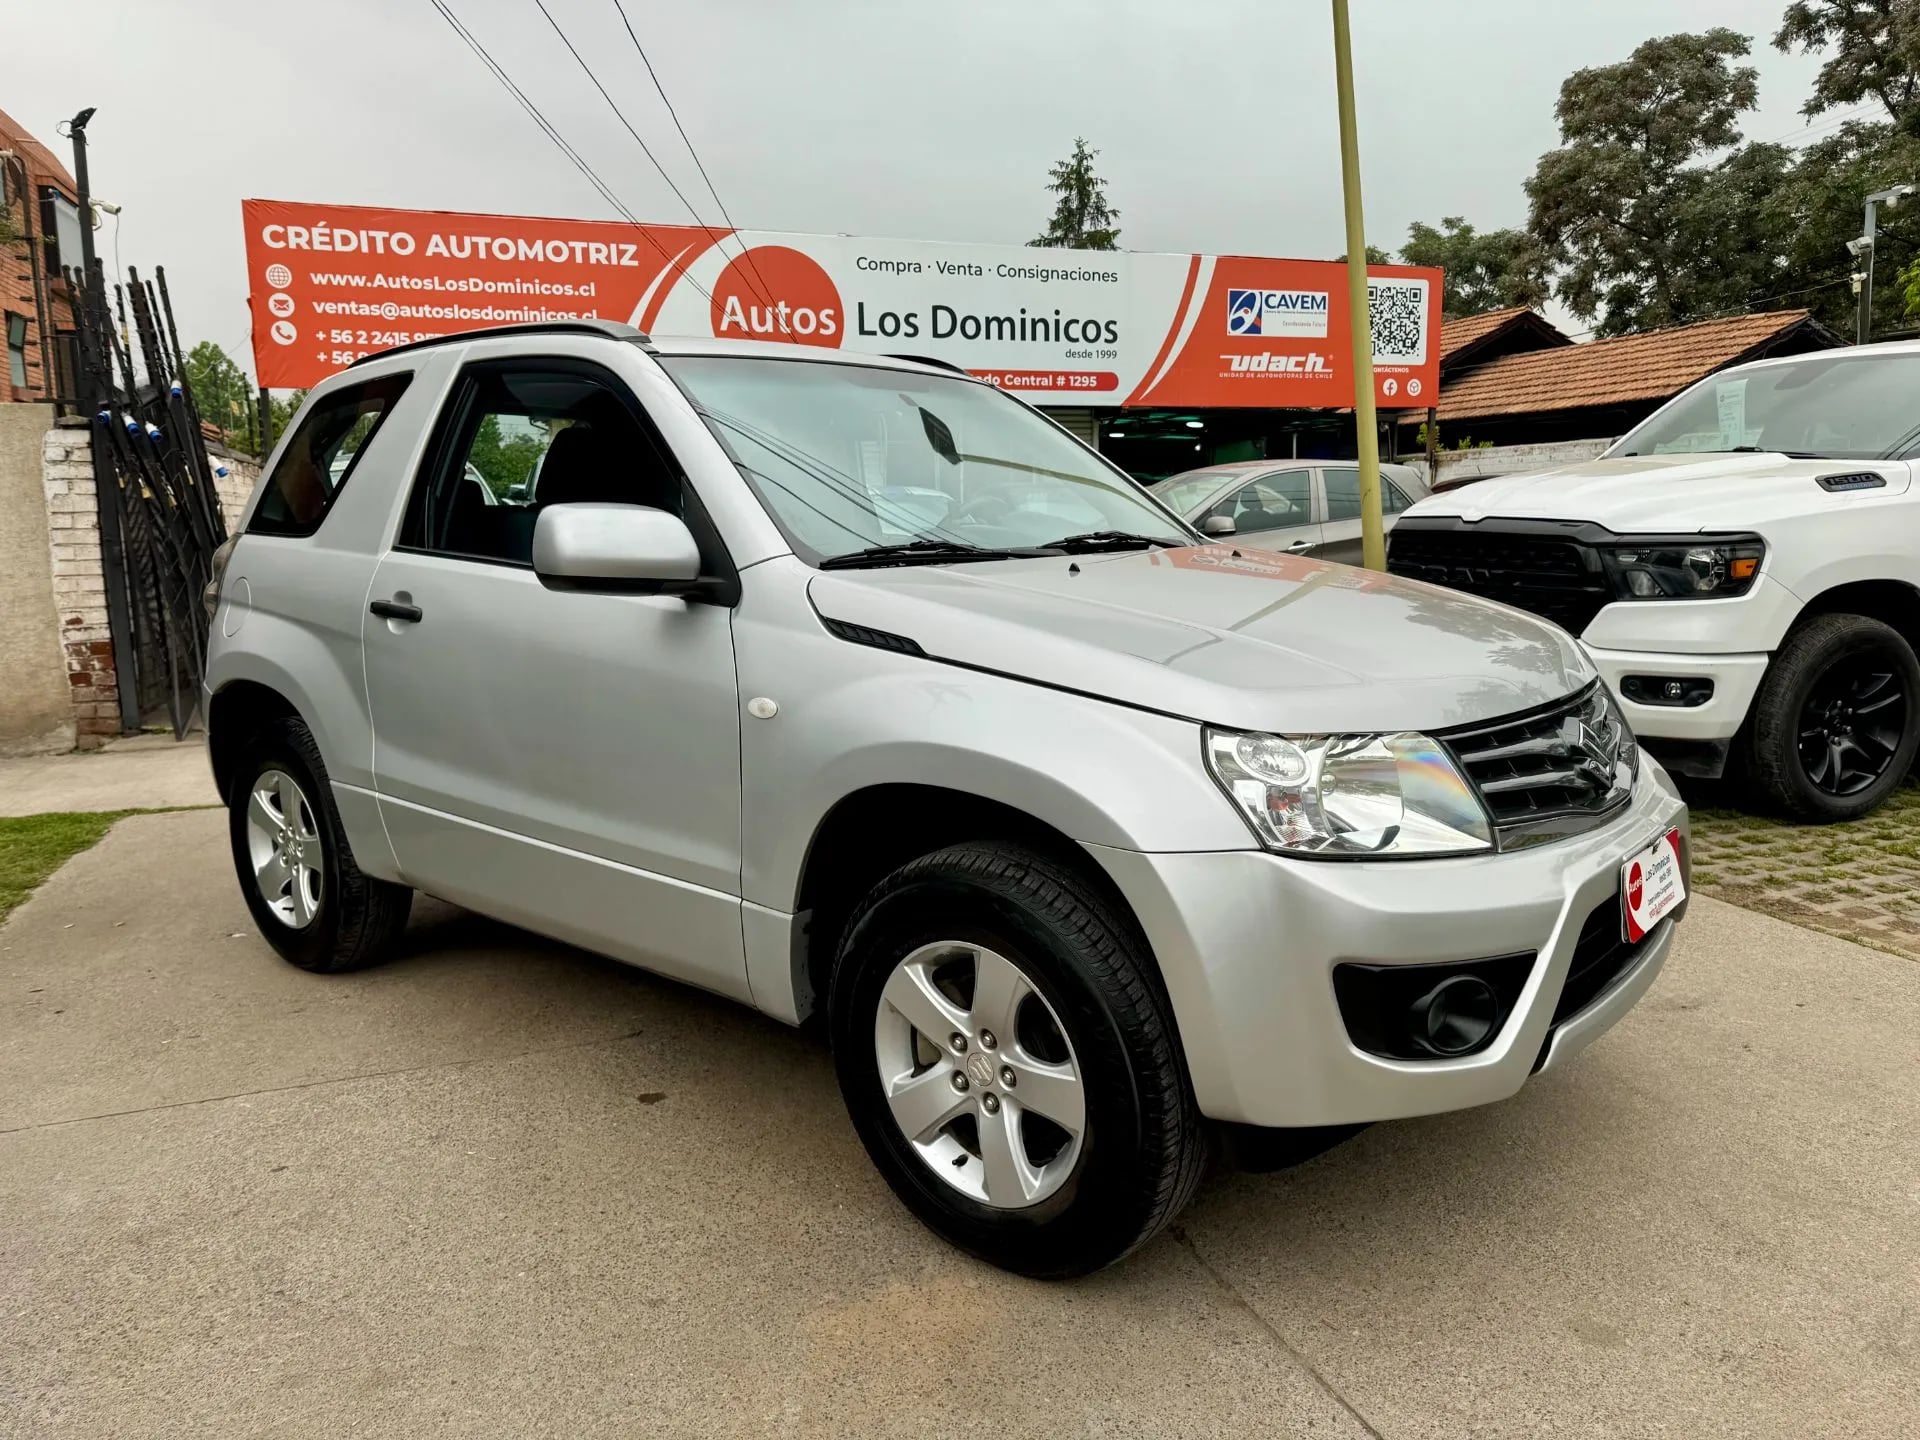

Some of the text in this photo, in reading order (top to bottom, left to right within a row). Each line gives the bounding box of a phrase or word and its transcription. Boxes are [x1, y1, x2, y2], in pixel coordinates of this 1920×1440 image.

[262, 221, 640, 267] CRÉDITO AUTOMOTRIZ
[856, 256, 1118, 282] Compra Venta Consignaciones
[310, 272, 596, 297] www.AutosLosDominicos.cl
[1264, 293, 1327, 310] CAVEM
[720, 295, 1119, 345] Autos Los Dominicos
[330, 329, 354, 344] 56
[356, 330, 369, 345] 2
[371, 331, 411, 346] 2415
[331, 351, 354, 365] 56
[1065, 349, 1118, 359] desde 1999
[1219, 352, 1333, 372] udach
[1373, 366, 1409, 374] ONTÁCTENOS
[1004, 374, 1053, 387] Central
[1056, 375, 1067, 386] #
[1068, 375, 1098, 388] 1295
[1826, 474, 1873, 486] 1500
